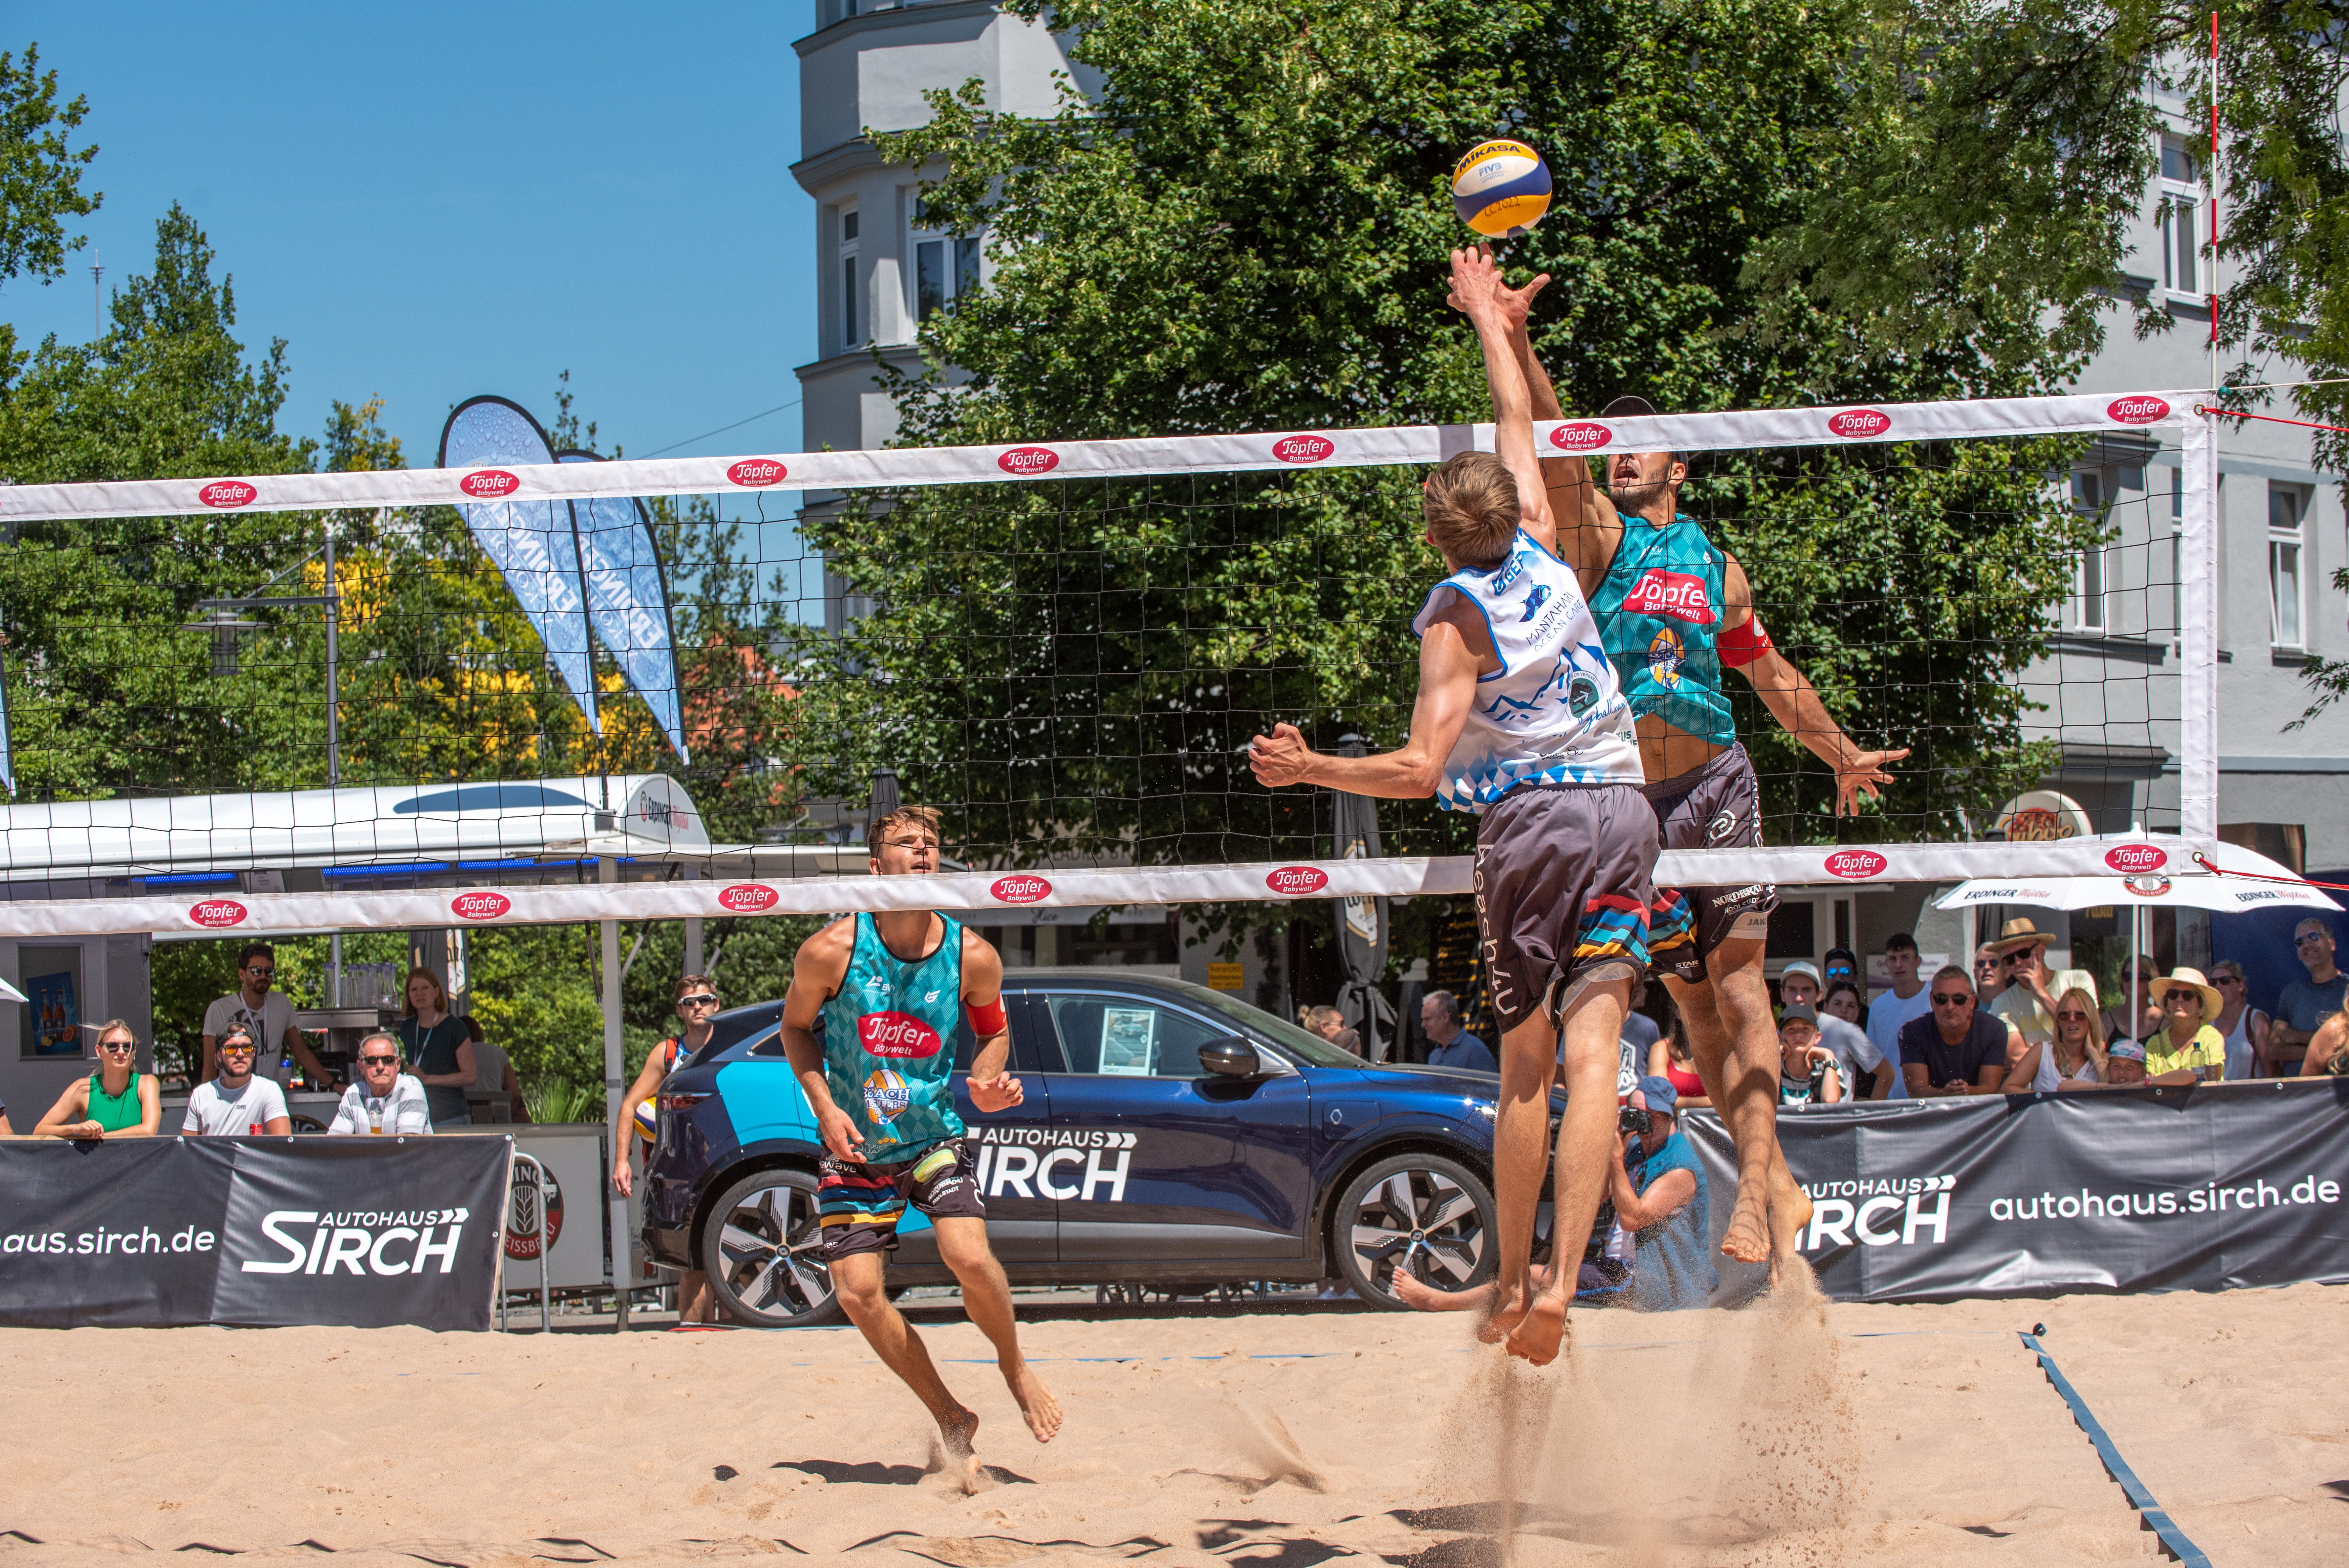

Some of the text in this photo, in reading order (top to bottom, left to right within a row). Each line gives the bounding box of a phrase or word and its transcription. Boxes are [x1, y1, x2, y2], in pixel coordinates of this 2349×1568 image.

[1482, 173, 1504, 184] APPROVED
[2117, 400, 2162, 415] Töpfer
[1839, 414, 1883, 429] Töpfer
[1560, 427, 1604, 442] Töpfer
[1283, 440, 1327, 455] Töpfer
[1008, 451, 1052, 467] Töpfer
[737, 463, 780, 479] Töpfer
[470, 474, 512, 490] Töpfer
[209, 485, 250, 500] Töpfer
[1630, 574, 1708, 608] Töpfe
[1644, 601, 1700, 620] Babywelt
[1526, 592, 1575, 645] MANTAHARI
[1534, 599, 1584, 651] OCEAN CARE
[1580, 672, 1597, 683] VERBAND
[1834, 855, 1879, 870] Töpfer
[2115, 849, 2160, 864] Töpfer
[1276, 871, 1321, 886] Töpfer
[1000, 880, 1044, 895] Töpfer
[1964, 889, 2018, 900] ERDINGER
[728, 888, 771, 903] Töpfer
[2235, 890, 2311, 902] ERDINGER Weißbier
[461, 896, 504, 911] Töpfer
[199, 904, 240, 919] Töpfer
[1675, 960, 1699, 968] STAR
[982, 1128, 1105, 1147] AUTOHAUS
[967, 1127, 1132, 1201] IRCH
[1800, 1178, 1922, 1199] AUTOHAUS
[1989, 1175, 2341, 1221] autohaus.sirch.de
[319, 1210, 438, 1227] AUTOHAUS
[0, 1224, 215, 1254] aus.sirch.de
[241, 1210, 462, 1276] SIRCH
